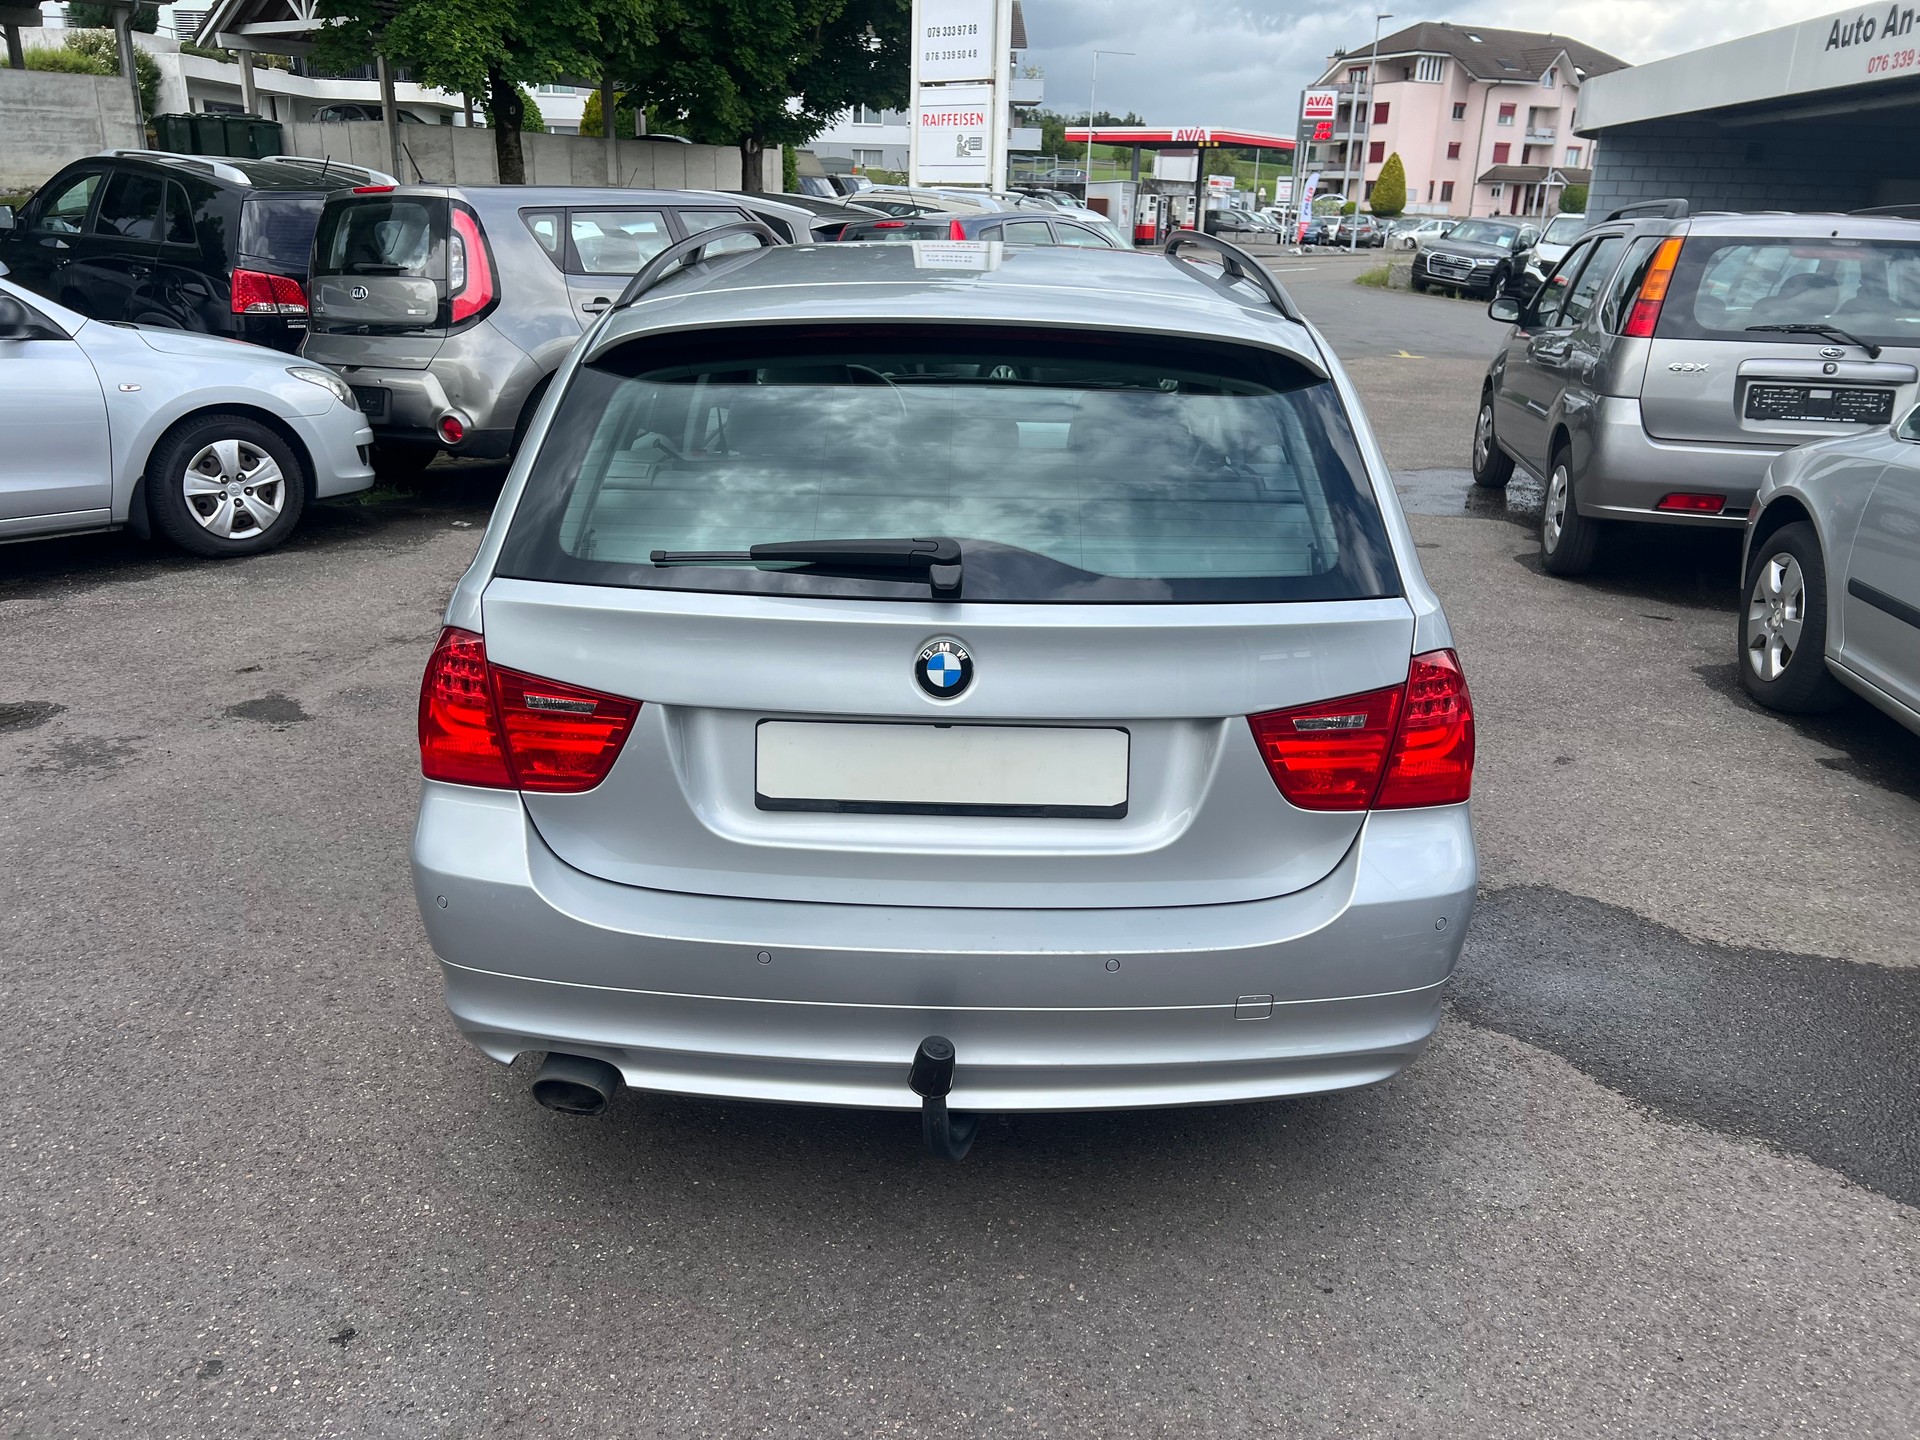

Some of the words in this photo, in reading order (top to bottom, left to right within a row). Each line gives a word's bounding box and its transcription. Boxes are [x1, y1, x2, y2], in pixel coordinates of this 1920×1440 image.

[927, 27, 940, 38] 079
[942, 26, 955, 36] 333
[957, 25, 967, 35] 97
[968, 24, 977, 34] 88
[1825, 13, 1876, 51] Auto
[925, 51, 939, 61] 076
[942, 50, 955, 60] 339
[1868, 54, 1890, 73] 076
[1892, 49, 1915, 69] 339
[923, 112, 984, 127] RAIFFEISEN
[1668, 362, 1710, 373] G3X
[921, 642, 968, 661] BMW
